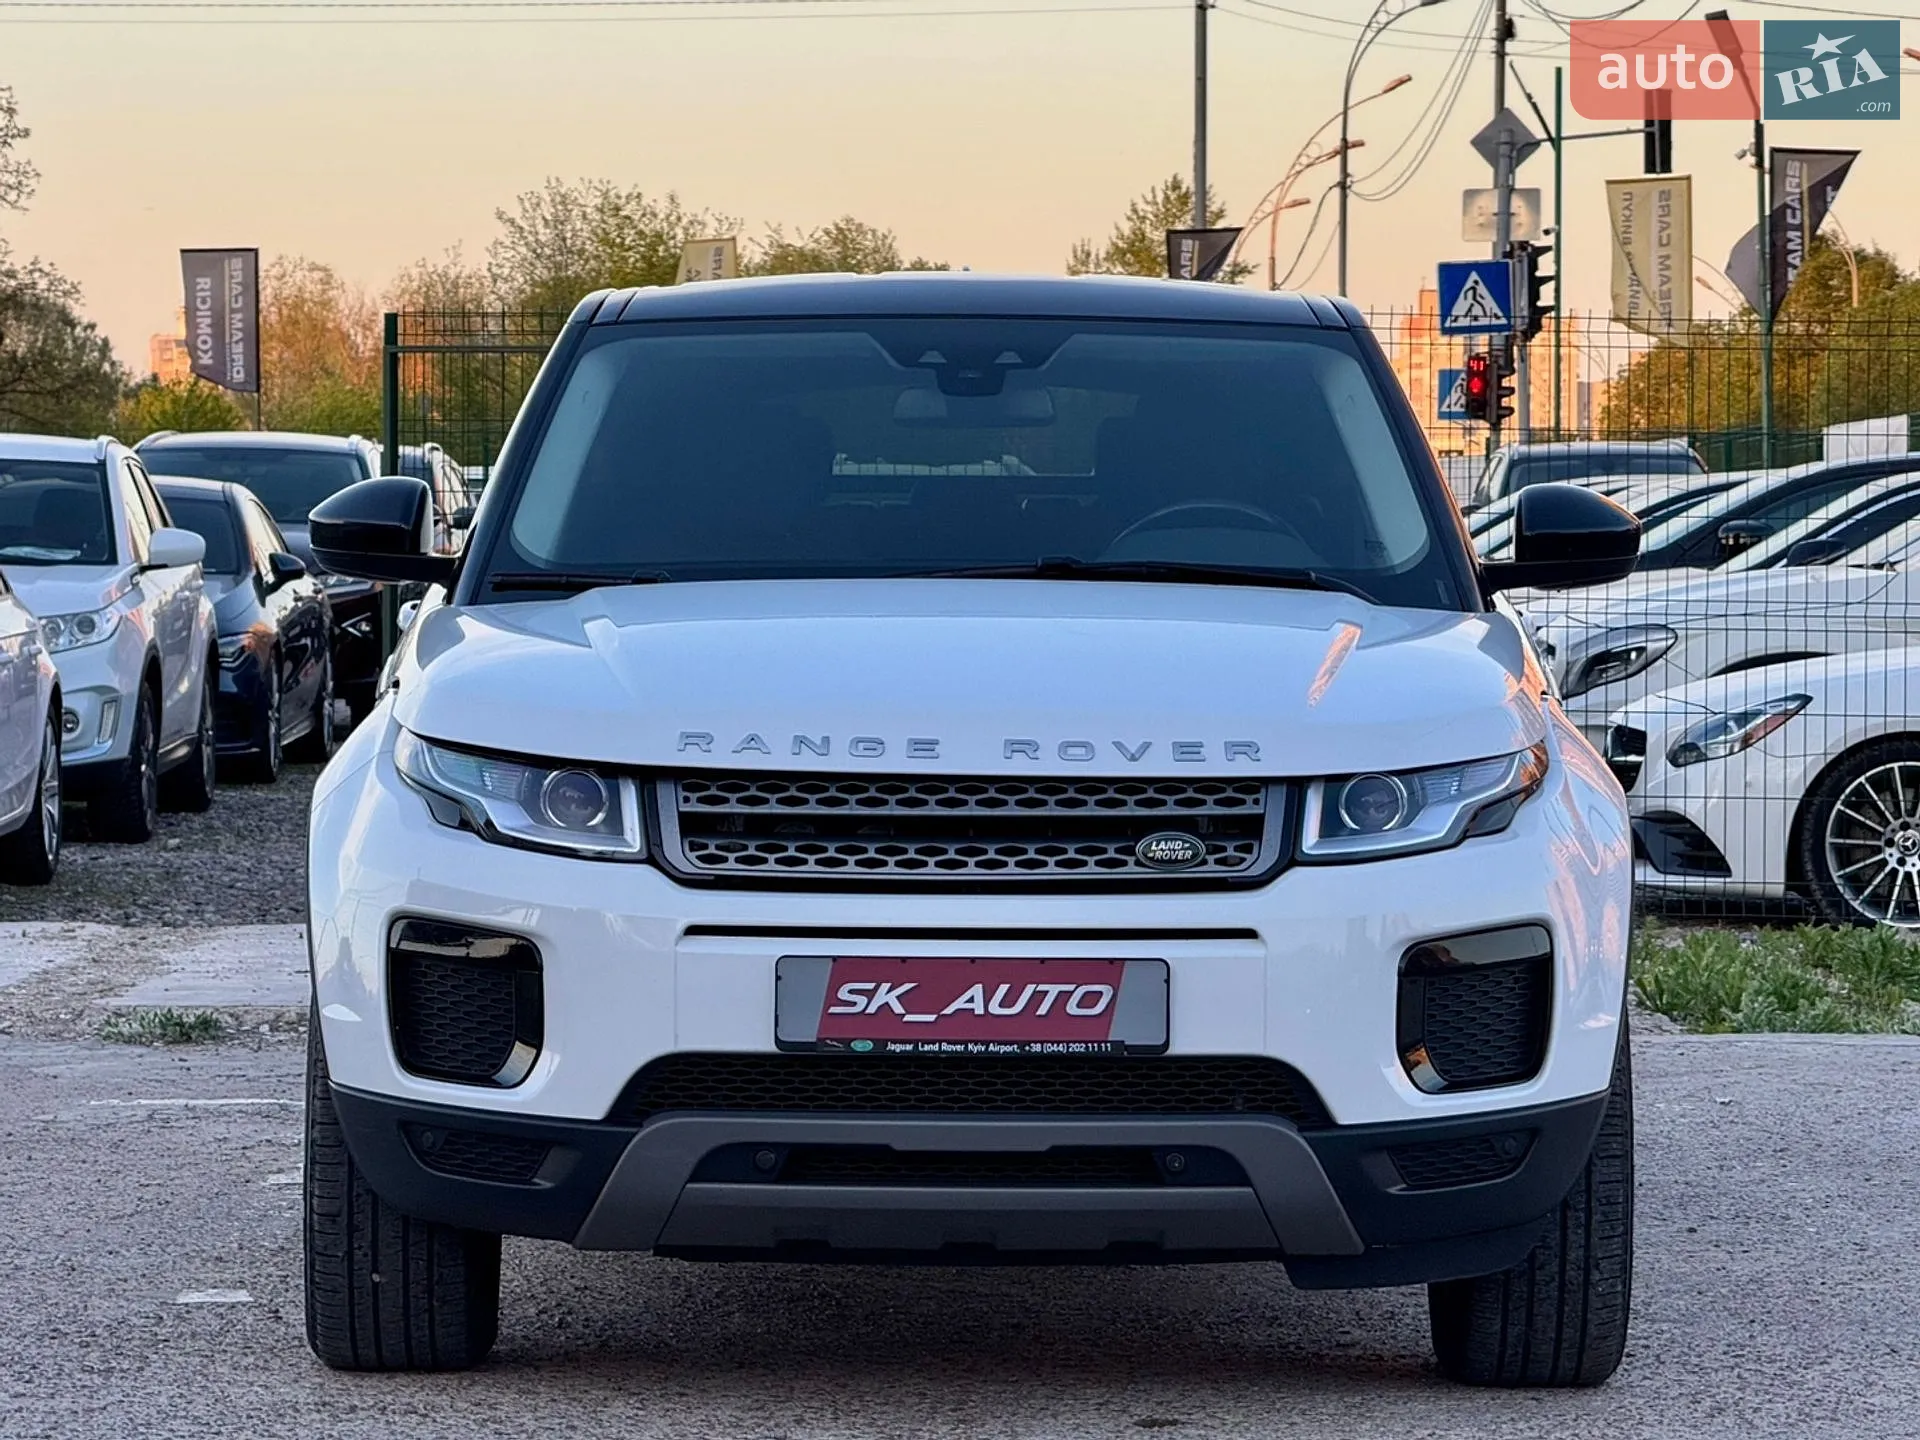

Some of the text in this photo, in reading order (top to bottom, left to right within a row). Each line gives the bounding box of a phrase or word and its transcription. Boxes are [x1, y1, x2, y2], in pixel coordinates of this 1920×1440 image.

[1785, 159, 1801, 225] CARS
[676, 731, 1261, 763] RANGE ROVER
[828, 982, 1114, 1022] SK_AUTO
[886, 1041, 1111, 1054] Jaguar Land Rover Kyiv Airport, +38 (044) 202 11 11
